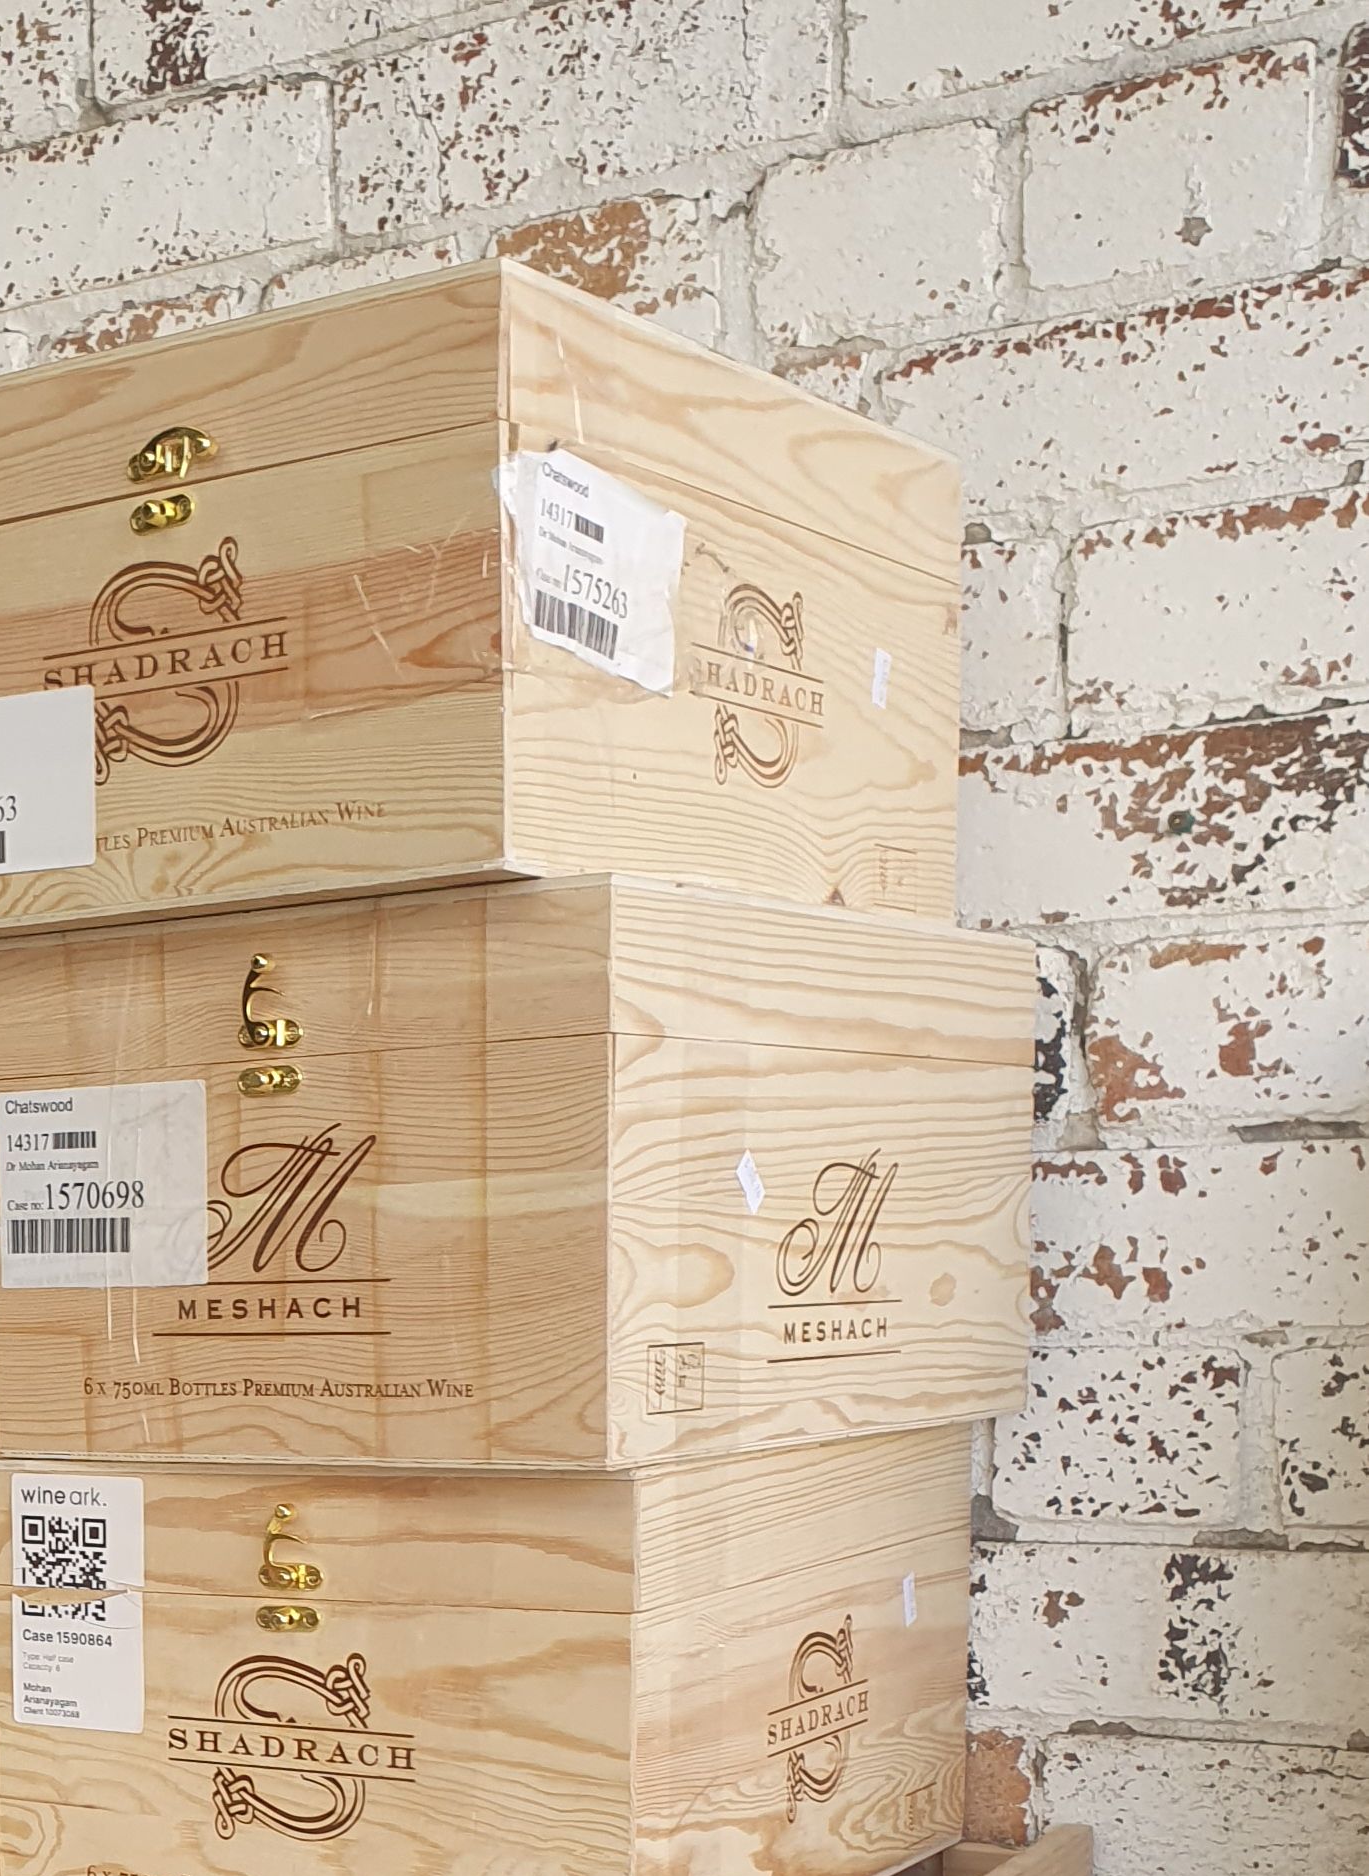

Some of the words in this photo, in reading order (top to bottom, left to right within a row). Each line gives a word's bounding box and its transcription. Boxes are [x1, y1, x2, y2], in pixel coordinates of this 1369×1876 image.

[540, 498, 573, 529] 14317
[563, 564, 628, 619] 1575263
[43, 631, 289, 690] SHADRACH
[5, 1097, 73, 1115] Chatswood
[7, 1133, 49, 1152] 14317
[46, 1180, 145, 1211] 1570698
[178, 1297, 362, 1320] MESHACH
[783, 1317, 888, 1344] MESHACH
[83, 1378, 93, 1396] 6
[21, 1486, 66, 1507] wine
[22, 1628, 54, 1643] Case
[56, 1631, 113, 1648] 1590864
[767, 1690, 870, 1747] SHADRACH
[168, 1728, 416, 1771] SHADRACH
